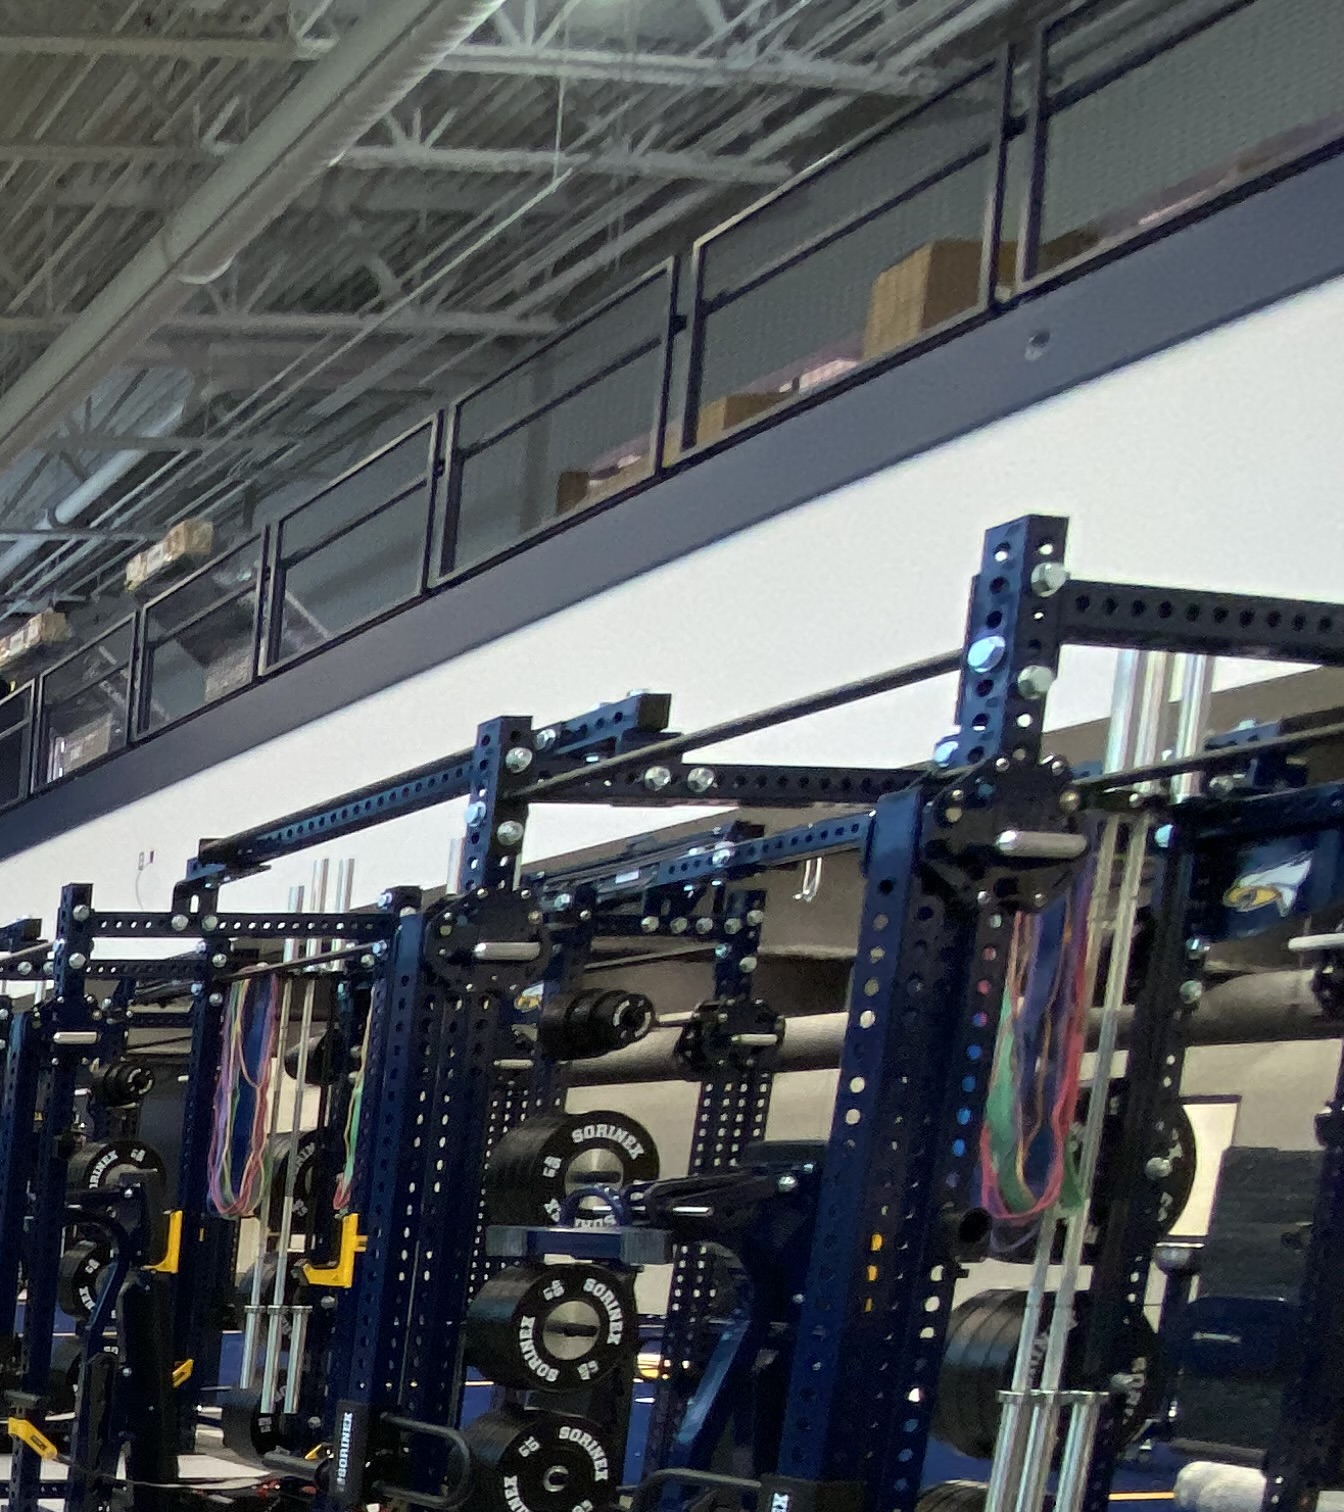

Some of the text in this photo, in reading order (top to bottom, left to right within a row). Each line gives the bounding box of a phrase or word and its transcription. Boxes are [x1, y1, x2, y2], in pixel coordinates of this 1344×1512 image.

[571, 1123, 645, 1160] SORINEX
[583, 1278, 623, 1345] SORINEX
[519, 1315, 560, 1382] SORINEX
[337, 1412, 353, 1478] SORINEX
[525, 1436, 541, 1452] 10
[559, 1426, 609, 1482] SORINEX
